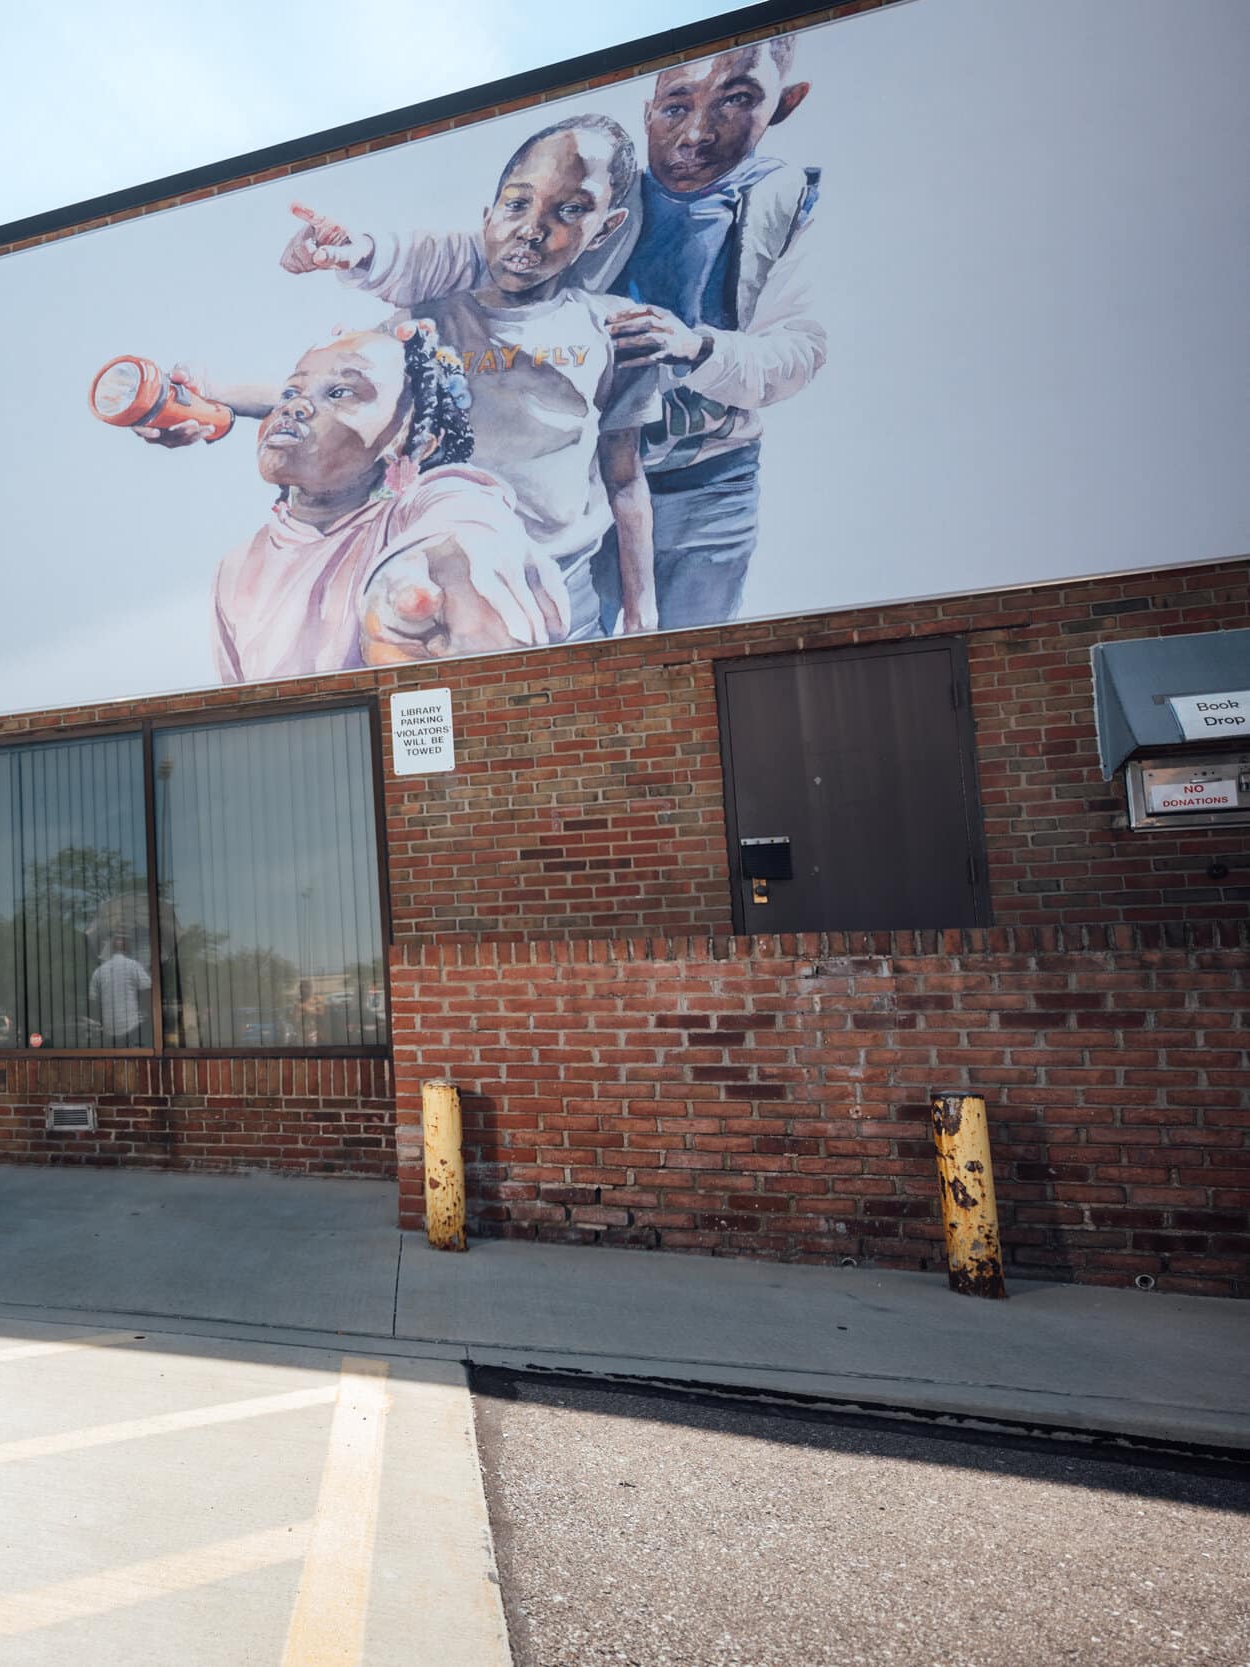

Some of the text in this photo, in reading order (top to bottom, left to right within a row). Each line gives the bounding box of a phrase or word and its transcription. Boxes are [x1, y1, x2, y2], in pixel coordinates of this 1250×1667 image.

[461, 344, 591, 373] TAY FLY
[401, 706, 442, 717] LIBRARY
[1196, 700, 1239, 712] Book
[400, 715, 444, 726] PARKING
[1204, 716, 1246, 727] Drop
[396, 726, 450, 738] VIOLATORS
[403, 736, 444, 747] WILL BE
[406, 746, 442, 756] TOWED
[1183, 784, 1205, 794] NO
[1162, 796, 1230, 807] DONATIONS
